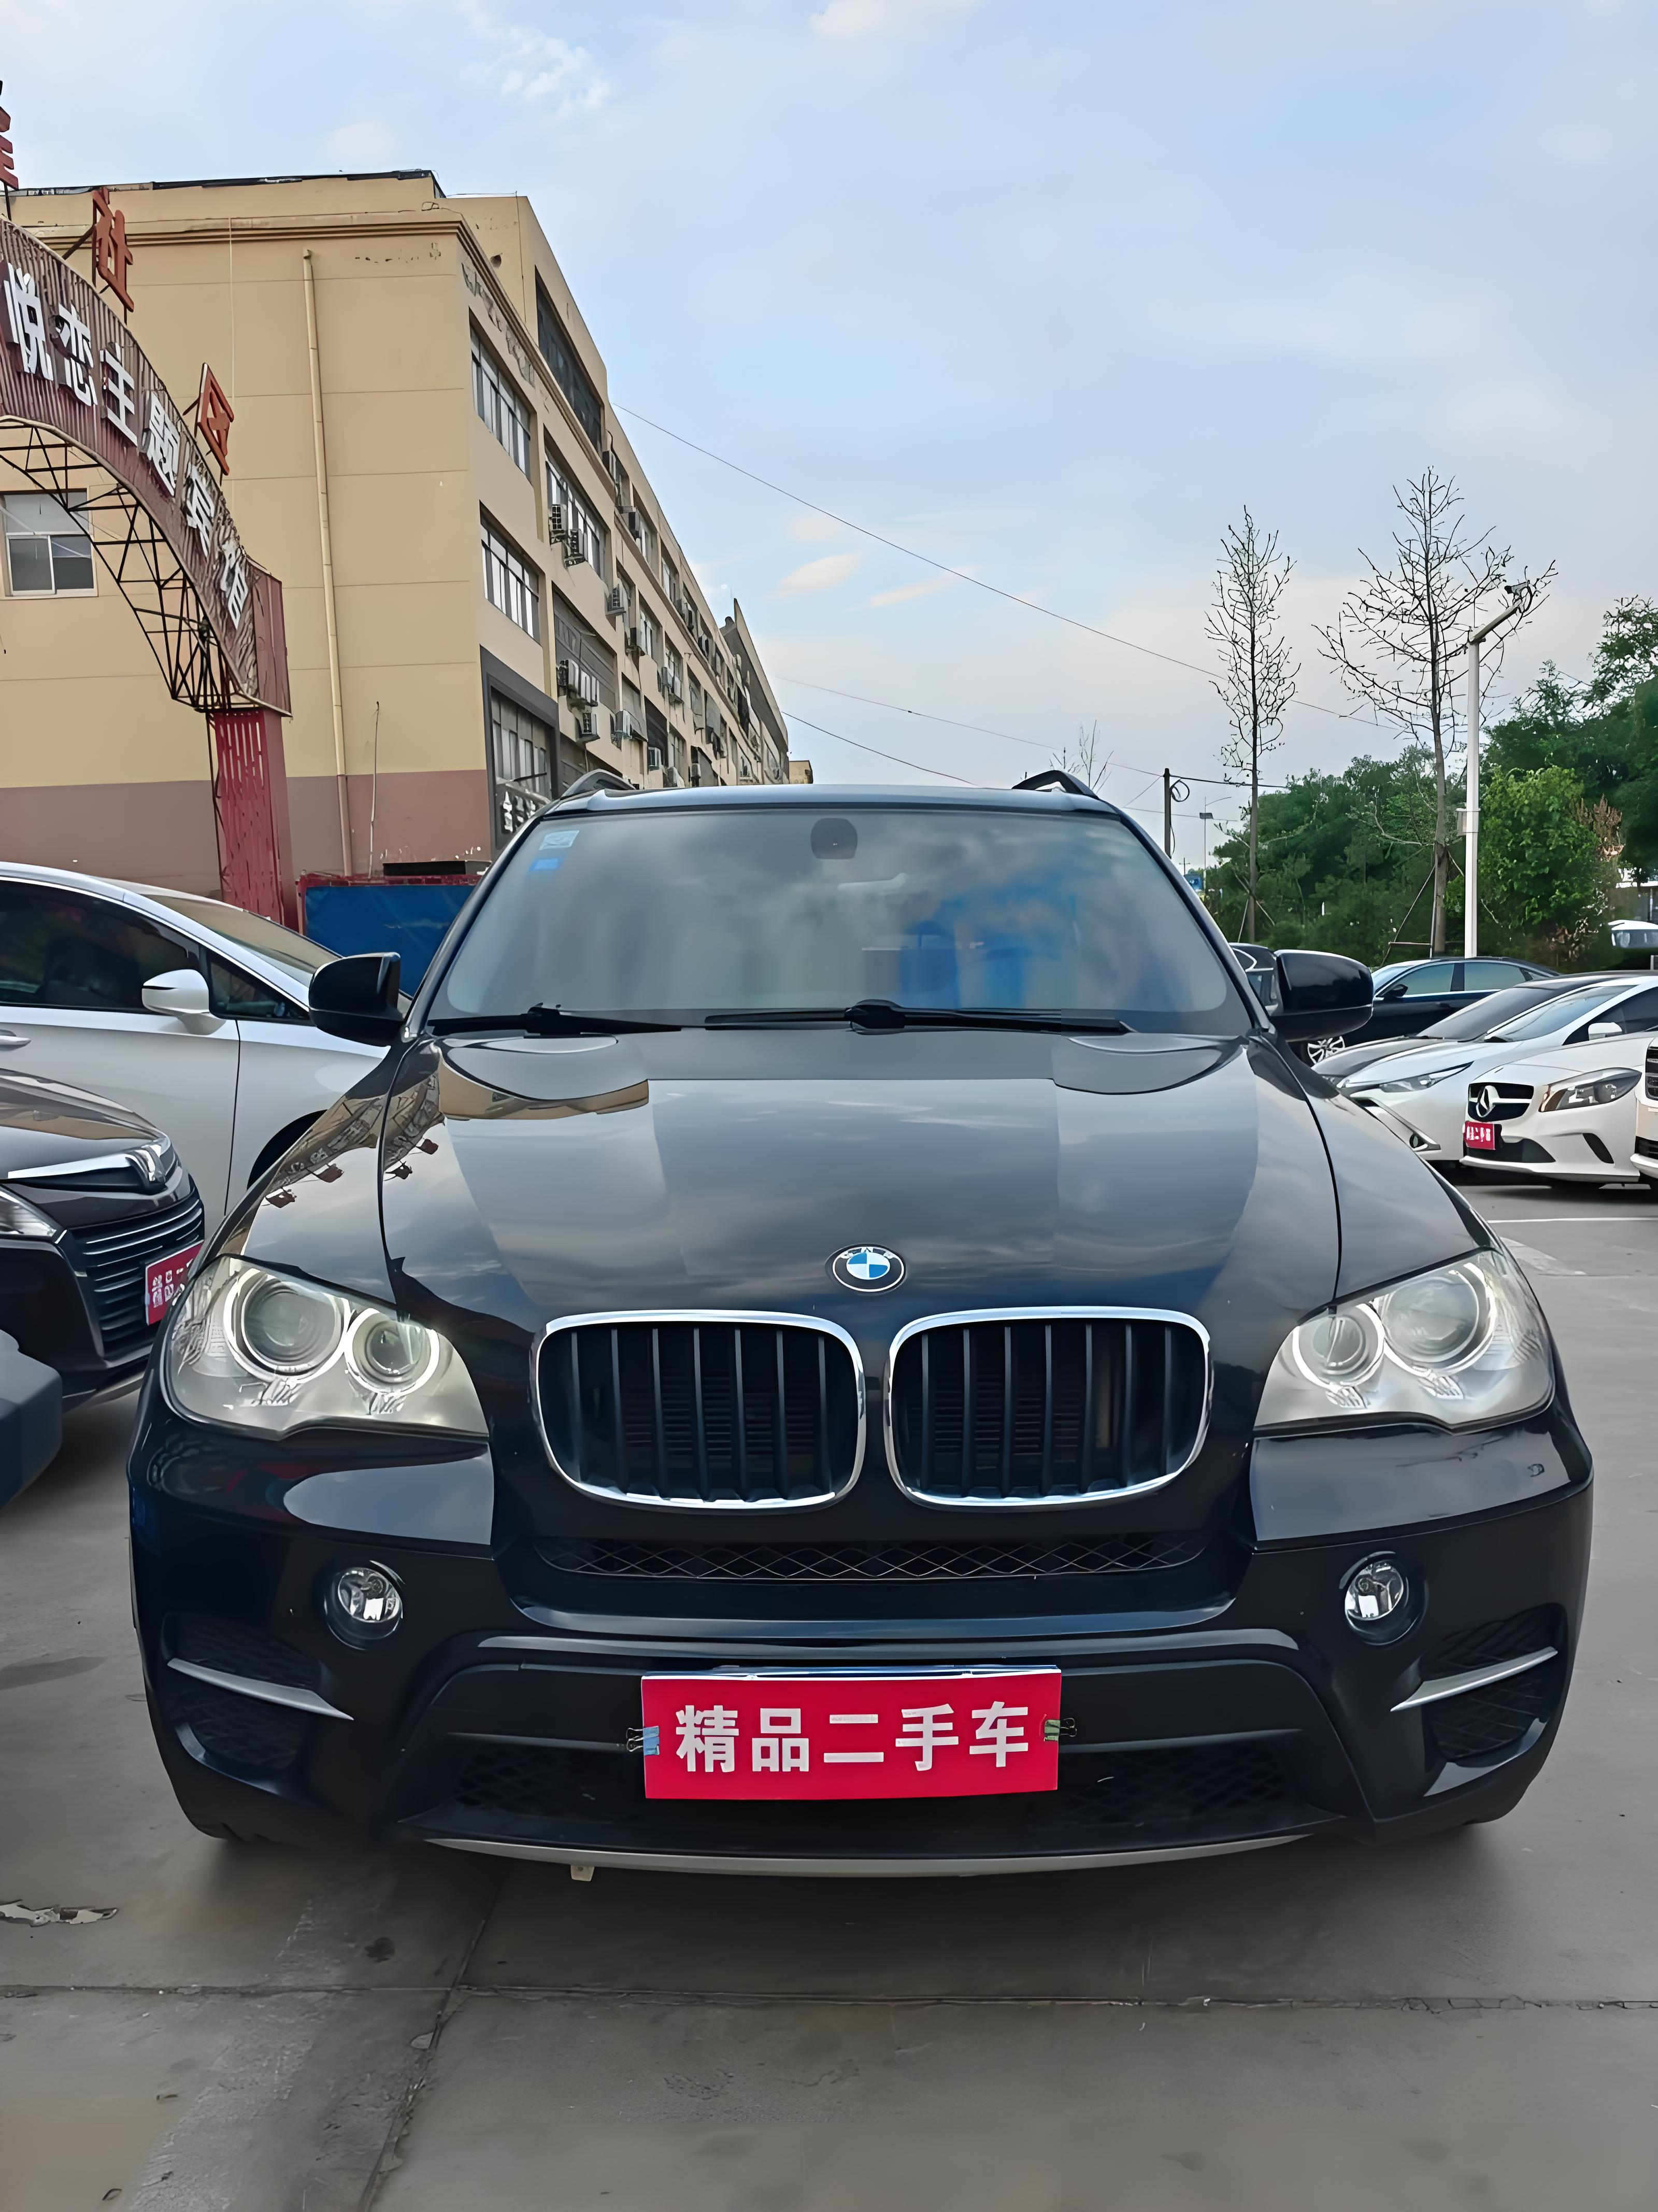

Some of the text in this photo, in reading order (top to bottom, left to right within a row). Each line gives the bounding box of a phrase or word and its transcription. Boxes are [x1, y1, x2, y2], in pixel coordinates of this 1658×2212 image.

[676, 1700, 1028, 1773] 精品二手车
